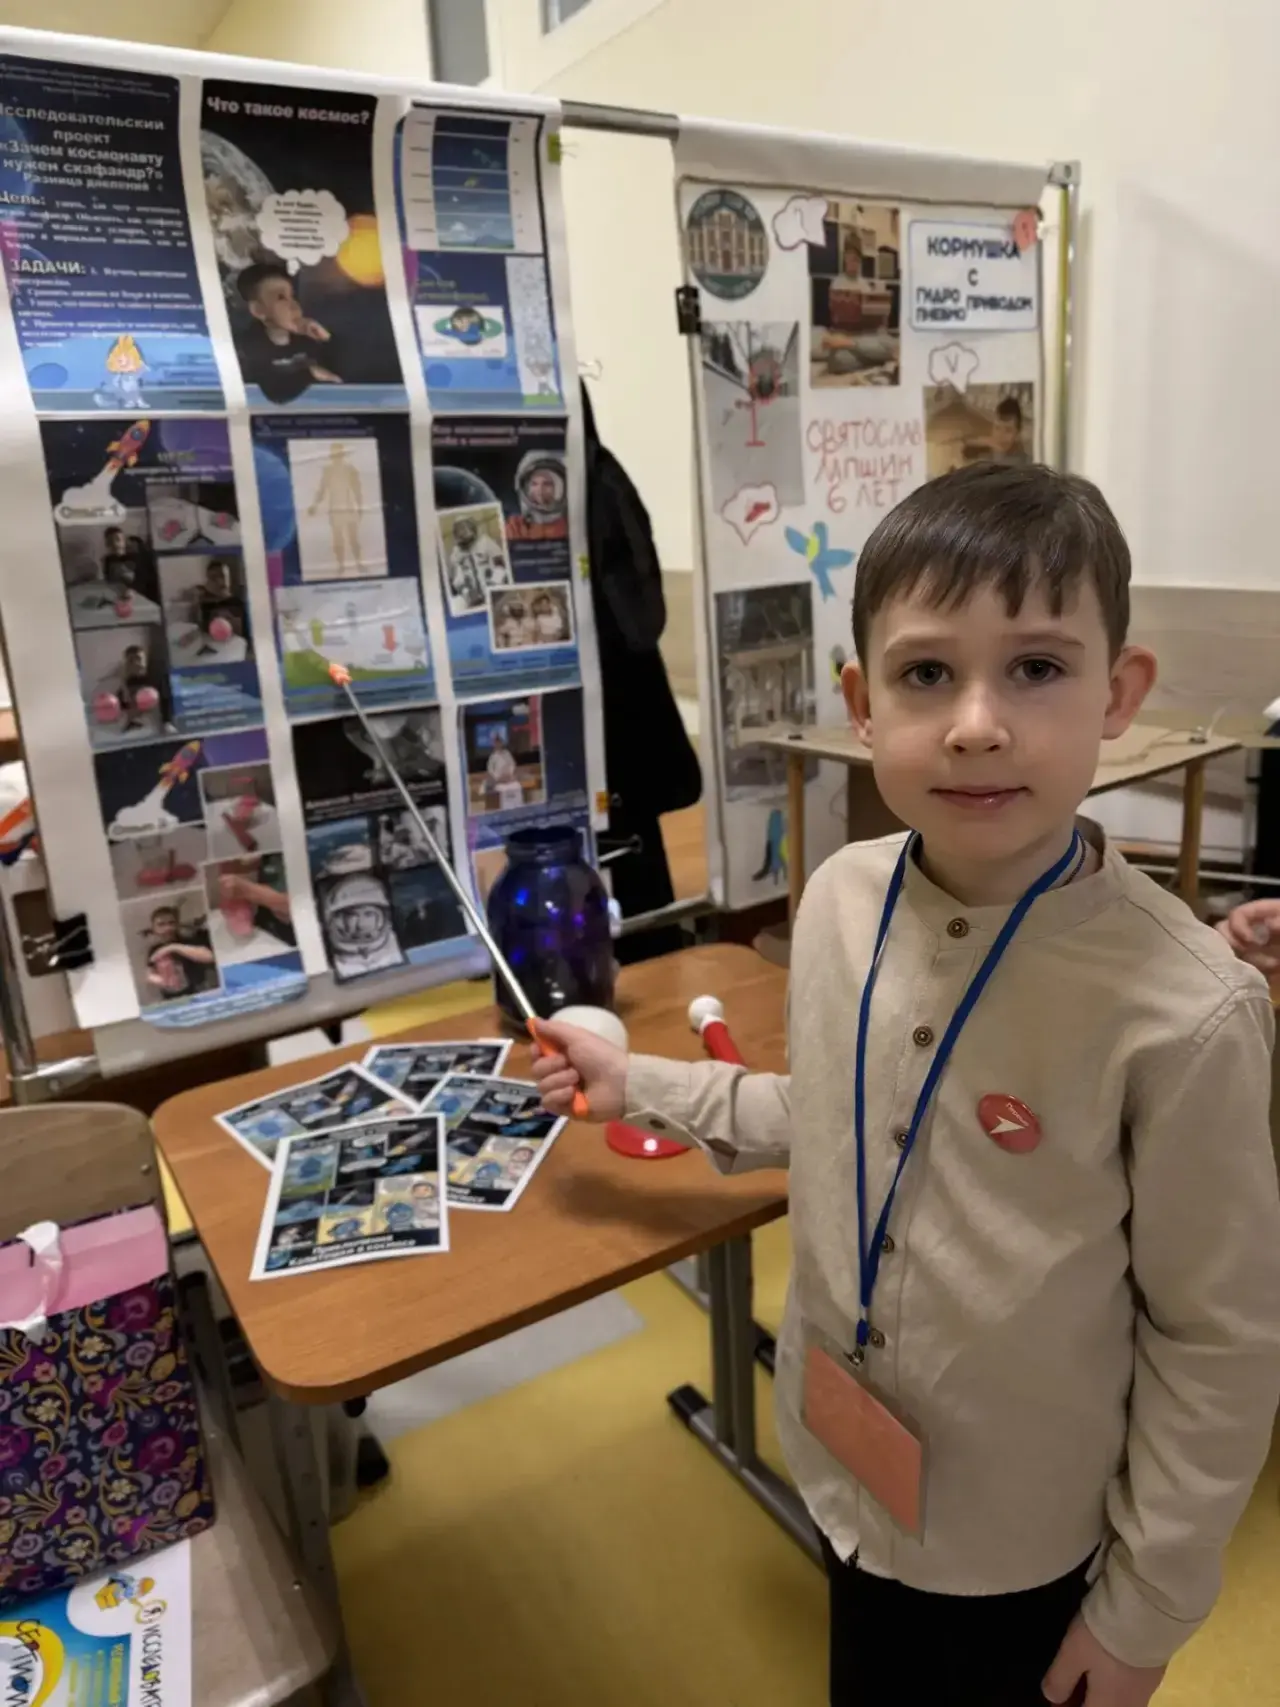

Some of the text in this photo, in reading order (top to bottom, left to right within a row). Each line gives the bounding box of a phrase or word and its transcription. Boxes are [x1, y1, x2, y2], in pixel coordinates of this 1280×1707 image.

[207, 96, 370, 125] Что такое космос?
[53, 129, 111, 144] проект
[3, 157, 59, 173] нужен
[67, 147, 164, 167] космонавту
[926, 235, 1021, 259] КОРМУШКА
[11, 258, 87, 275] ЗАДАЧИ:
[916, 286, 961, 305] ГИДРО
